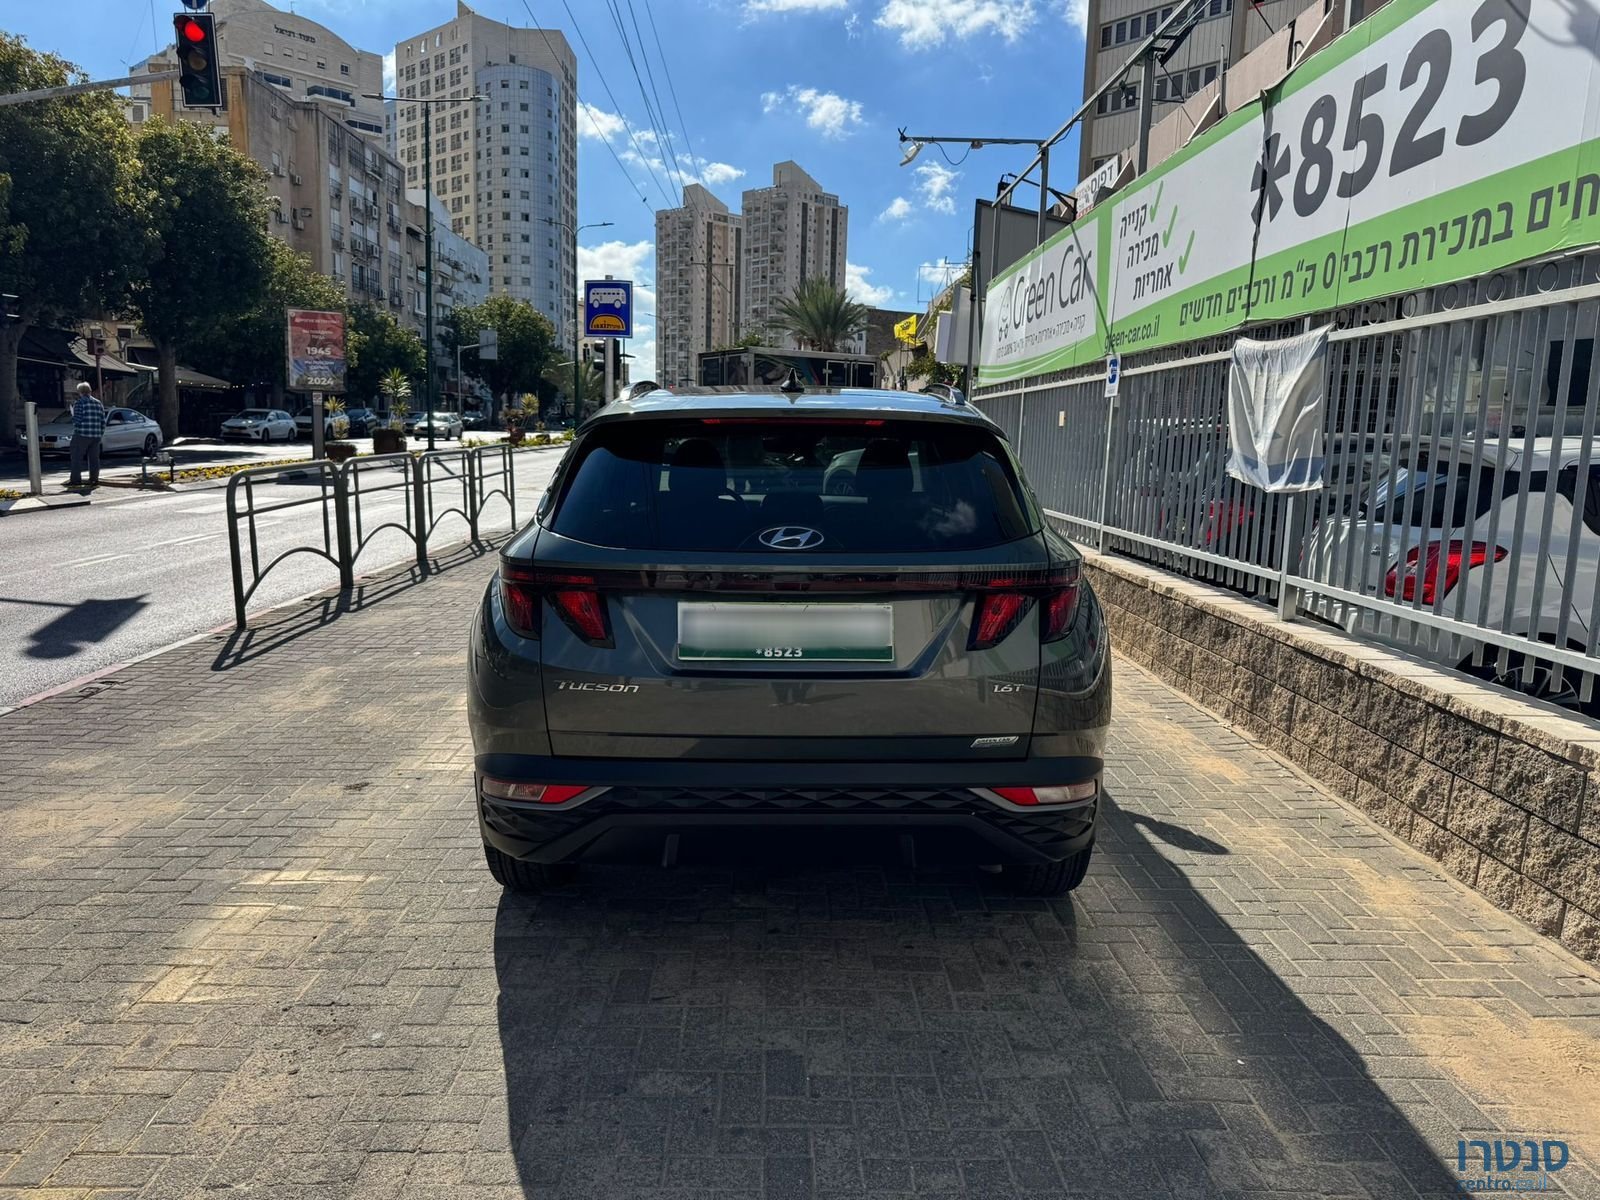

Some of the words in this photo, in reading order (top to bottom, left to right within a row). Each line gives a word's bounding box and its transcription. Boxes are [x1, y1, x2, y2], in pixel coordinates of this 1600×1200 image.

[1091, 164, 1114, 194] דפוס
[1120, 203, 1148, 239] קנייה
[1398, 201, 1514, 270] במכירת
[1127, 232, 1159, 269] מכירה
[1343, 240, 1392, 283] רכבי
[1013, 272, 1055, 330] Green
[1058, 244, 1092, 309] Car
[1133, 262, 1174, 300] אחריות
[1322, 252, 1336, 290] 0
[1179, 292, 1222, 326] חדשים
[1226, 275, 1276, 314] ורכבים
[306, 347, 332, 355] 1945
[1104, 314, 1161, 353] green-car.co.il
[307, 377, 334, 385] 2024
